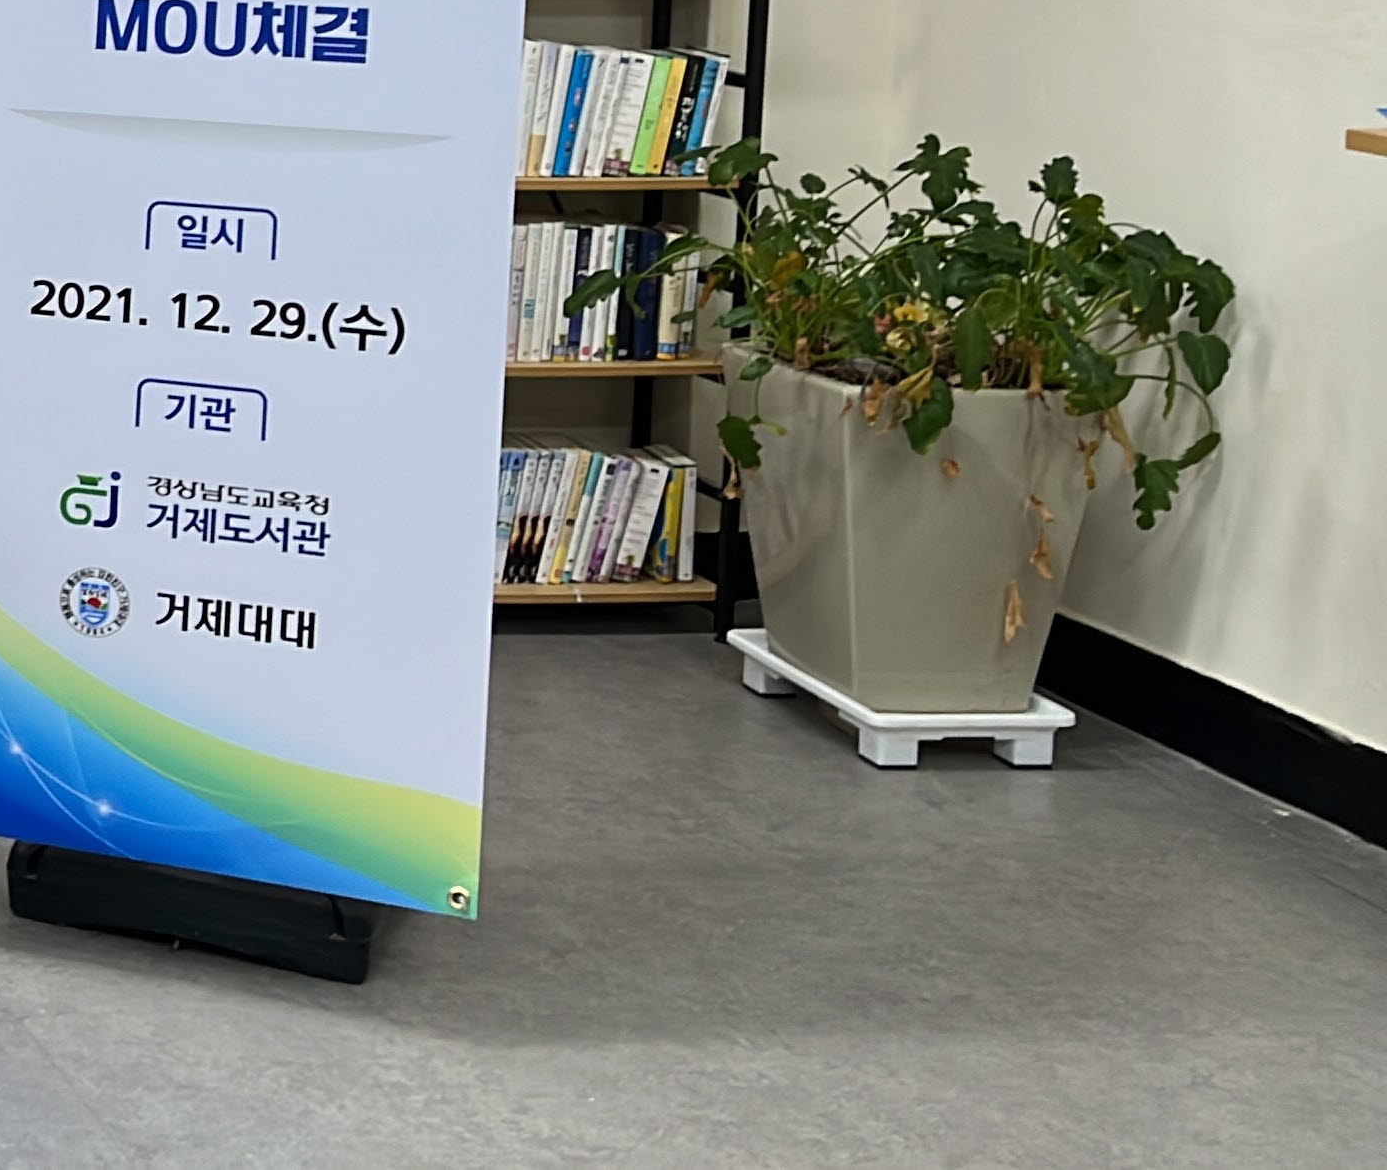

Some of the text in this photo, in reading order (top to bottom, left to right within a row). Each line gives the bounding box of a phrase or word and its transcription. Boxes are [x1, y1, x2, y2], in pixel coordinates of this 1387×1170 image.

[176, 214, 245, 254] 일시
[30, 278, 407, 356] 2021. 12. 29.(수)
[164, 393, 236, 433] 기관
[147, 476, 330, 516] 경상남도교육청
[146, 503, 331, 557] 거제도서관
[155, 592, 316, 650] 거제대대
